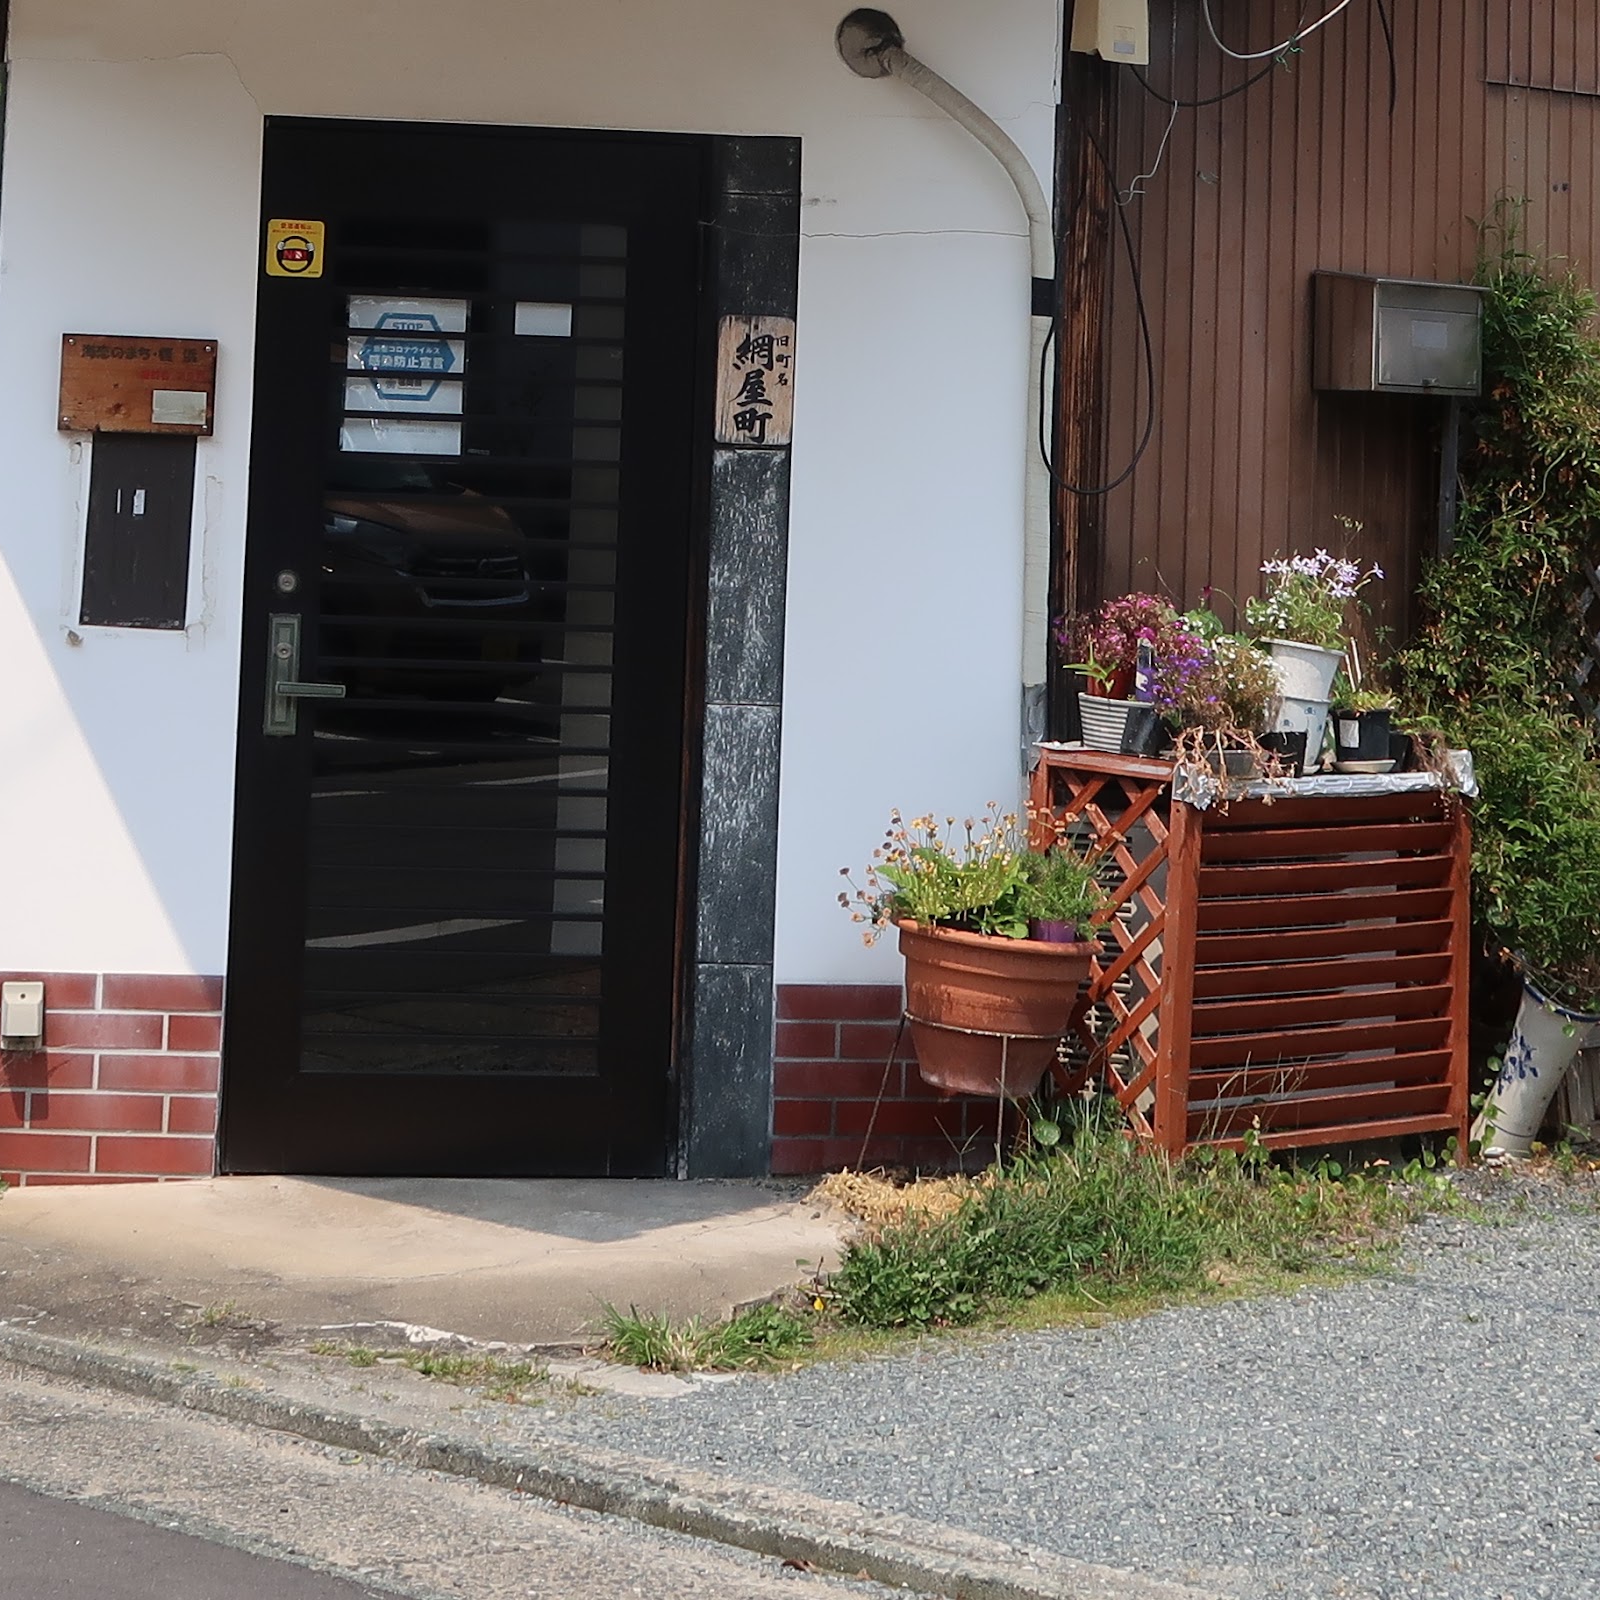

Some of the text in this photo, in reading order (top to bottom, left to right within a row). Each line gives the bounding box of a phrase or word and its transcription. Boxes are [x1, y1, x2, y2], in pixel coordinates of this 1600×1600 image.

[392, 322, 423, 331] STOP
[775, 335, 791, 386] 旧町名
[728, 333, 773, 443] 網屋町
